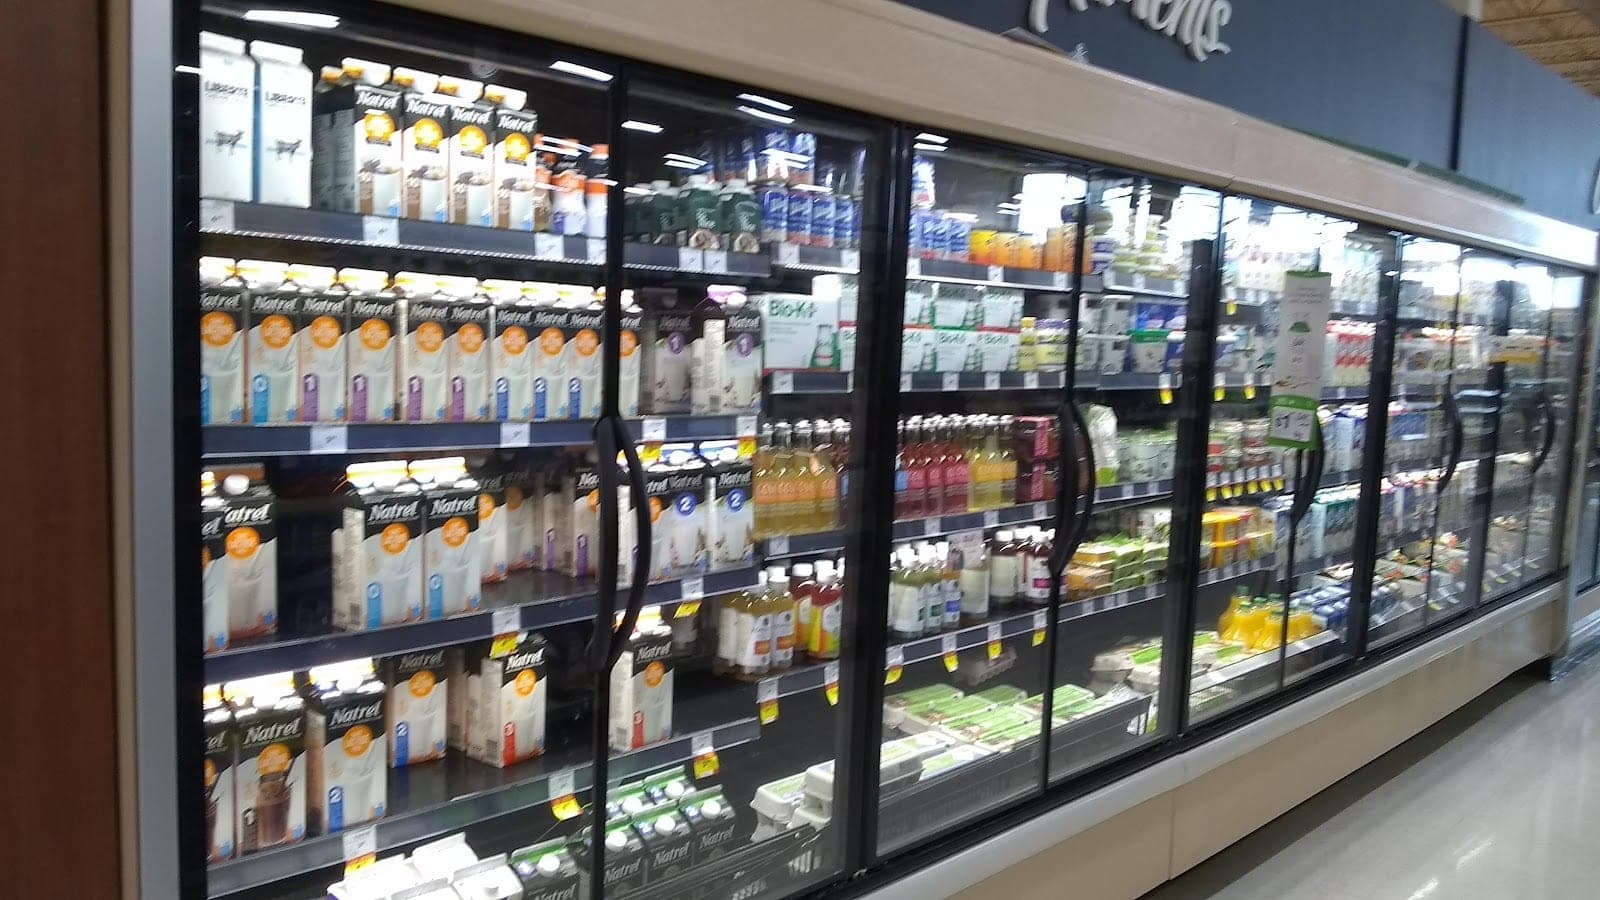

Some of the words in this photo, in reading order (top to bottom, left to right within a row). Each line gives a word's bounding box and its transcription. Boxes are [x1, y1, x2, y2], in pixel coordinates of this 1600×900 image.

[356, 90, 397, 110] Natrel
[405, 97, 446, 118] Natrel
[451, 106, 491, 125] Natrel
[498, 115, 537, 133] Natrel
[252, 295, 298, 312] Natrel
[302, 296, 345, 313] Natrel
[353, 301, 395, 316] Natrel
[497, 378, 508, 392] 2
[534, 377, 545, 391] 2
[570, 377, 580, 391] 2
[432, 495, 478, 517] Natrel
[679, 496, 692, 512] 2
[731, 491, 742, 507] 2
[368, 501, 418, 522] Natrel
[506, 648, 544, 671] Natrel
[328, 700, 383, 726] Natrel
[243, 716, 304, 746] Natrel
[329, 789, 343, 804] 2
[700, 825, 736, 850] Natrel
[653, 842, 691, 867] Natrel
[604, 857, 642, 883] Natrel
